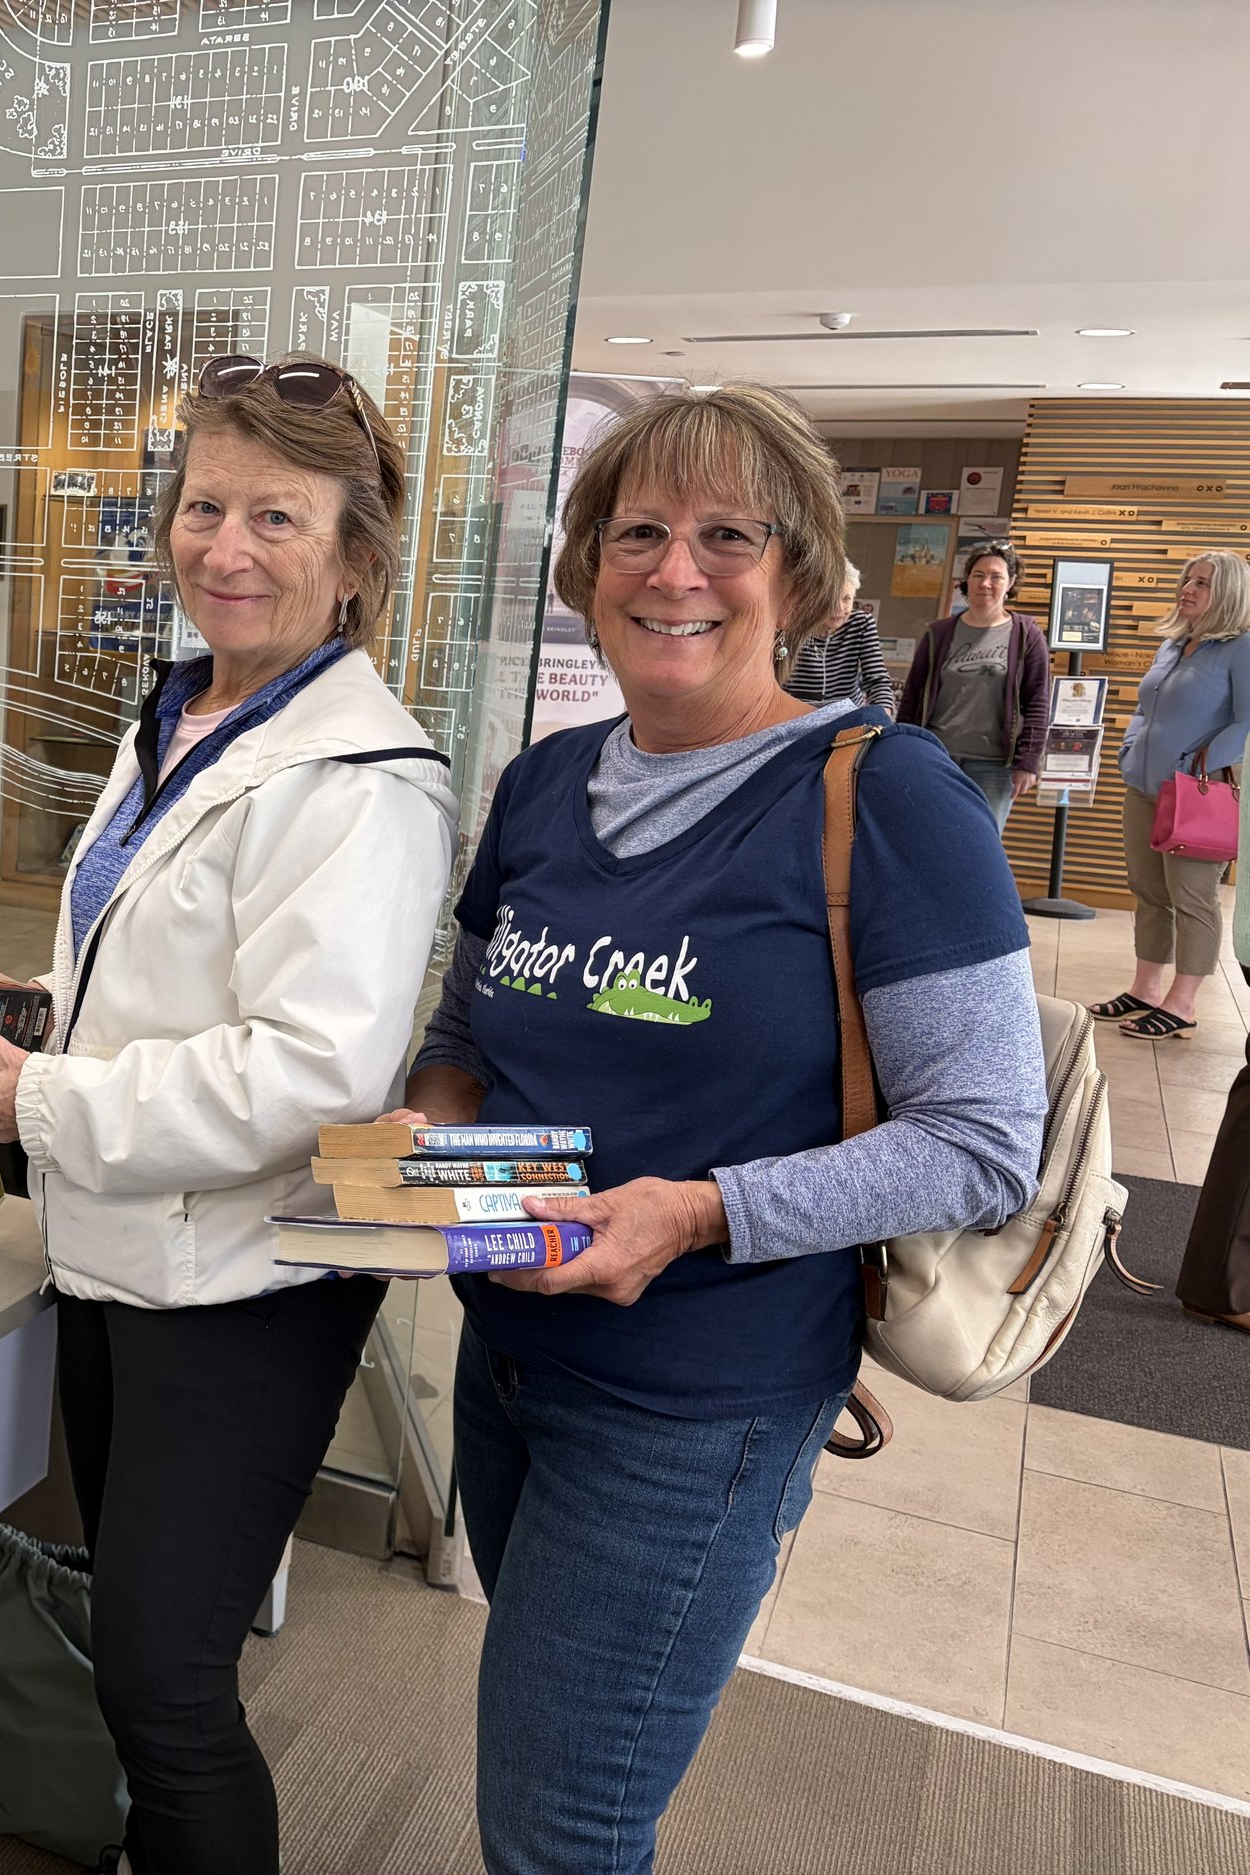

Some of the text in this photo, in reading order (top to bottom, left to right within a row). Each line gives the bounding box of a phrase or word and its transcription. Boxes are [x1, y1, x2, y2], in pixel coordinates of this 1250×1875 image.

[884, 468, 919, 478] YOGA
[1110, 483, 1131, 491] Joan
[537, 658, 595, 670] BRINGLEY
[548, 672, 608, 686] BEAUTY
[536, 689, 598, 702] WORLD"
[583, 935, 698, 1001] Creek
[518, 1162, 540, 1173] KEY
[438, 1169, 471, 1181] WHITE
[479, 1192, 521, 1213] CAPTIVA
[485, 1234, 504, 1251] LEE
[507, 1232, 535, 1250] CHILD
[546, 1229, 558, 1262] REACHER
[490, 1251, 535, 1265] ANDREW CHILD
